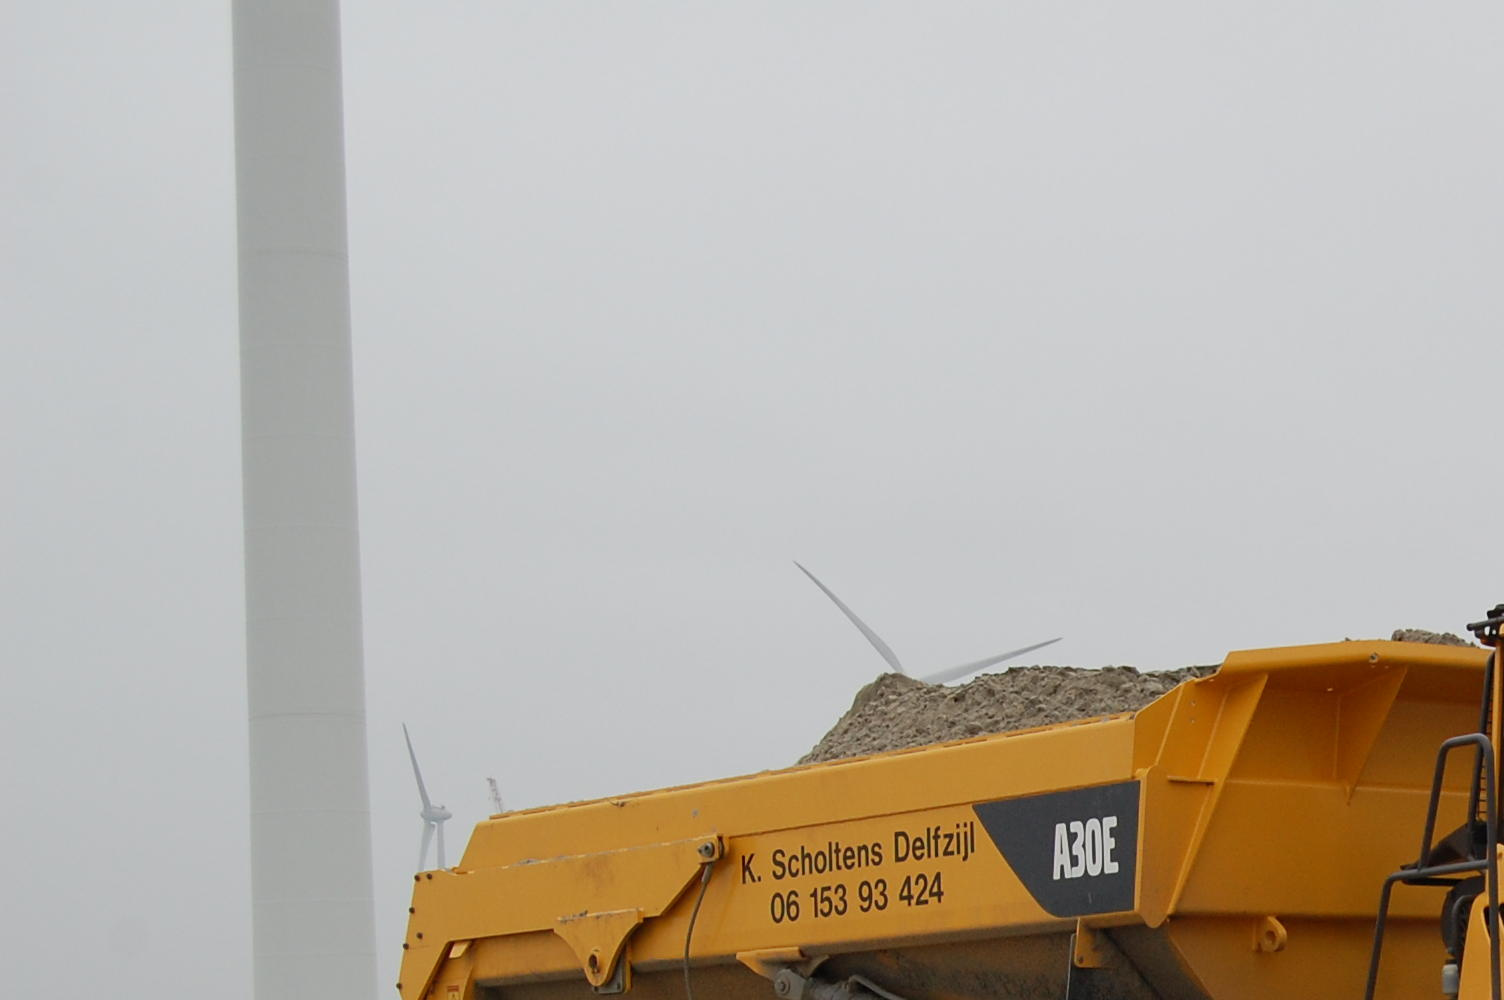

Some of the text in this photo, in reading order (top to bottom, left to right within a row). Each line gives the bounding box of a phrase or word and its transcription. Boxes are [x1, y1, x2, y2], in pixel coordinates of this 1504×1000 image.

[741, 821, 975, 885] K. Scholtens Delfzijl
[1053, 816, 1119, 880] A30E
[770, 871, 944, 924] 06 153 93 424
